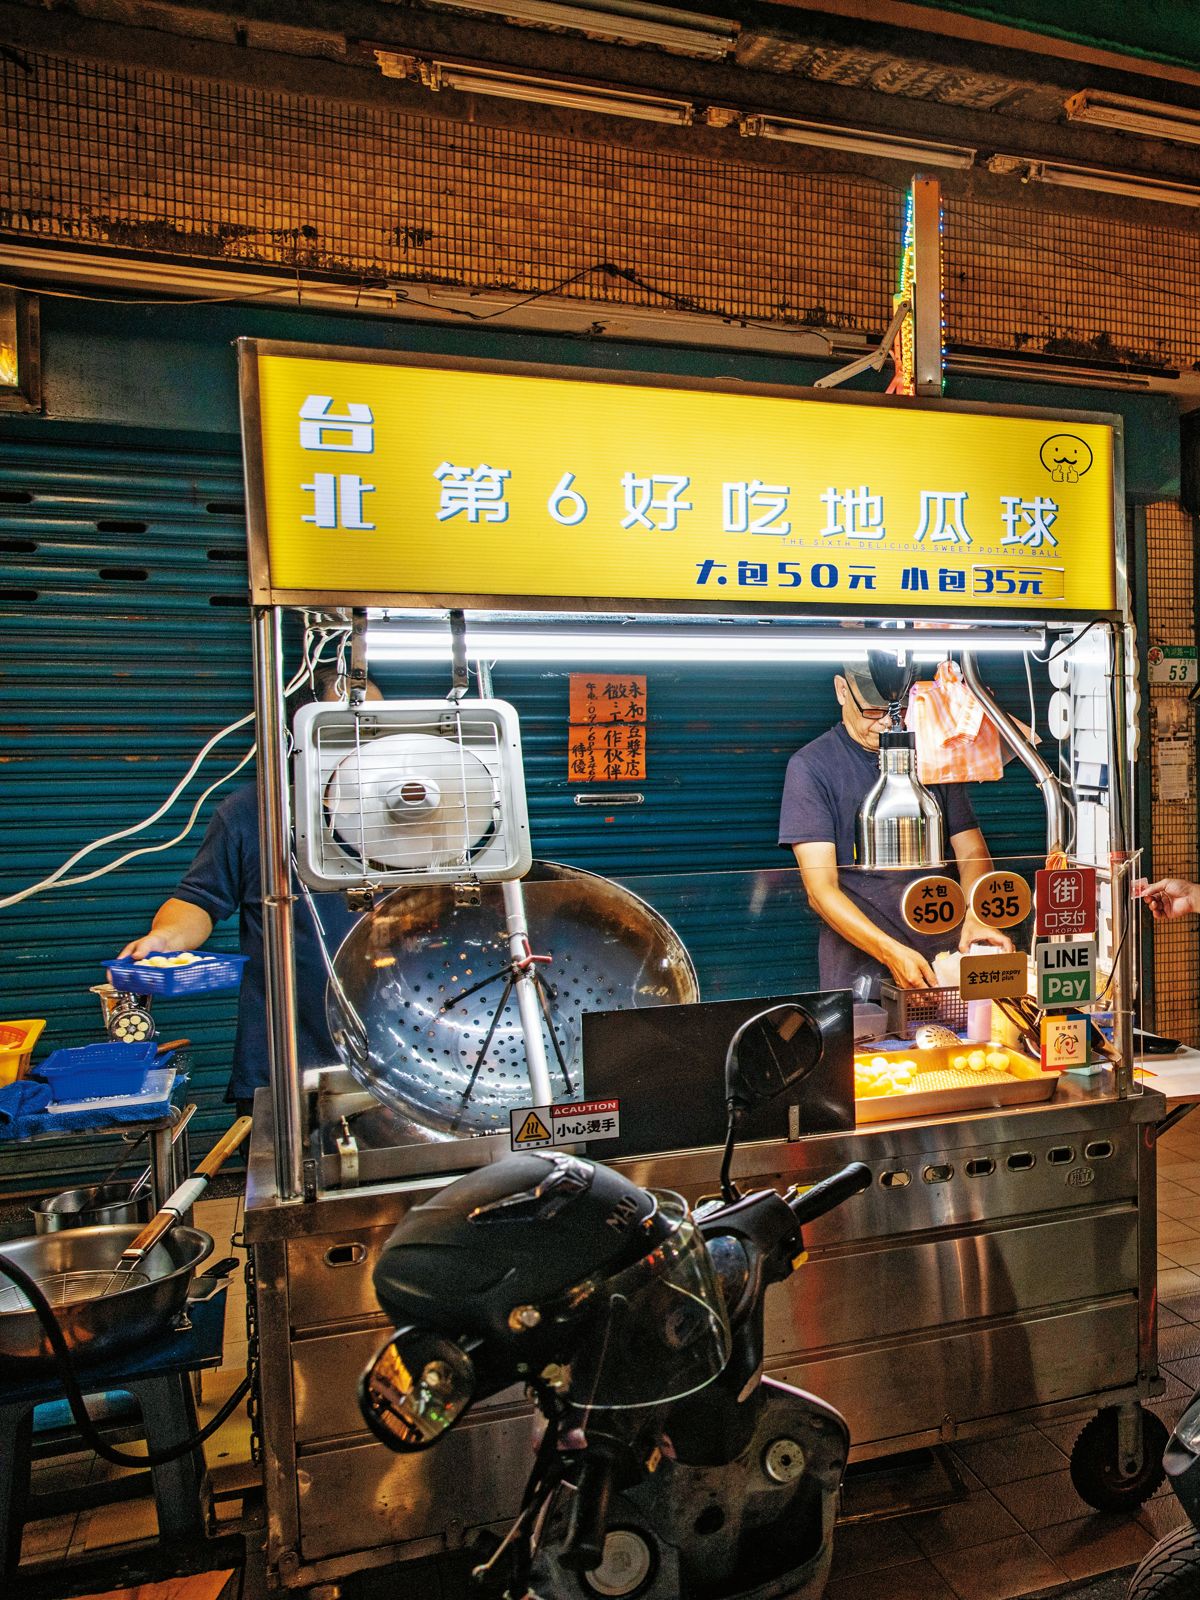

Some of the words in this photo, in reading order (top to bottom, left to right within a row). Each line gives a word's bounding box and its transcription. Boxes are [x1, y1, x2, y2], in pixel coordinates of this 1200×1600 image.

[299, 394, 376, 530] 台北
[432, 461, 1060, 549] 第6好吃地瓜球
[782, 537, 803, 546] THE
[813, 539, 851, 548] SIXTH
[859, 541, 927, 551] DELICIOUS
[933, 544, 973, 553] SWEET
[979, 547, 1025, 556] POTATO
[1031, 549, 1060, 558] BALL
[695, 559, 878, 590] 大包50元
[900, 566, 1044, 596] 小包35元
[1168, 665, 1188, 681] 53
[921, 884, 948, 899] 大包
[989, 880, 1015, 894] 小包
[1052, 876, 1079, 904] 街
[912, 901, 955, 924] $50
[981, 896, 1020, 918] $35
[1044, 909, 1087, 928] 口支付
[1049, 927, 1083, 935] JKOPAY
[1044, 947, 1089, 969] LINE
[967, 970, 1001, 985] 全支付
[1048, 977, 1087, 1000] Pay
[562, 1101, 617, 1115] CAUTION
[556, 1117, 617, 1138] 小心燙手
